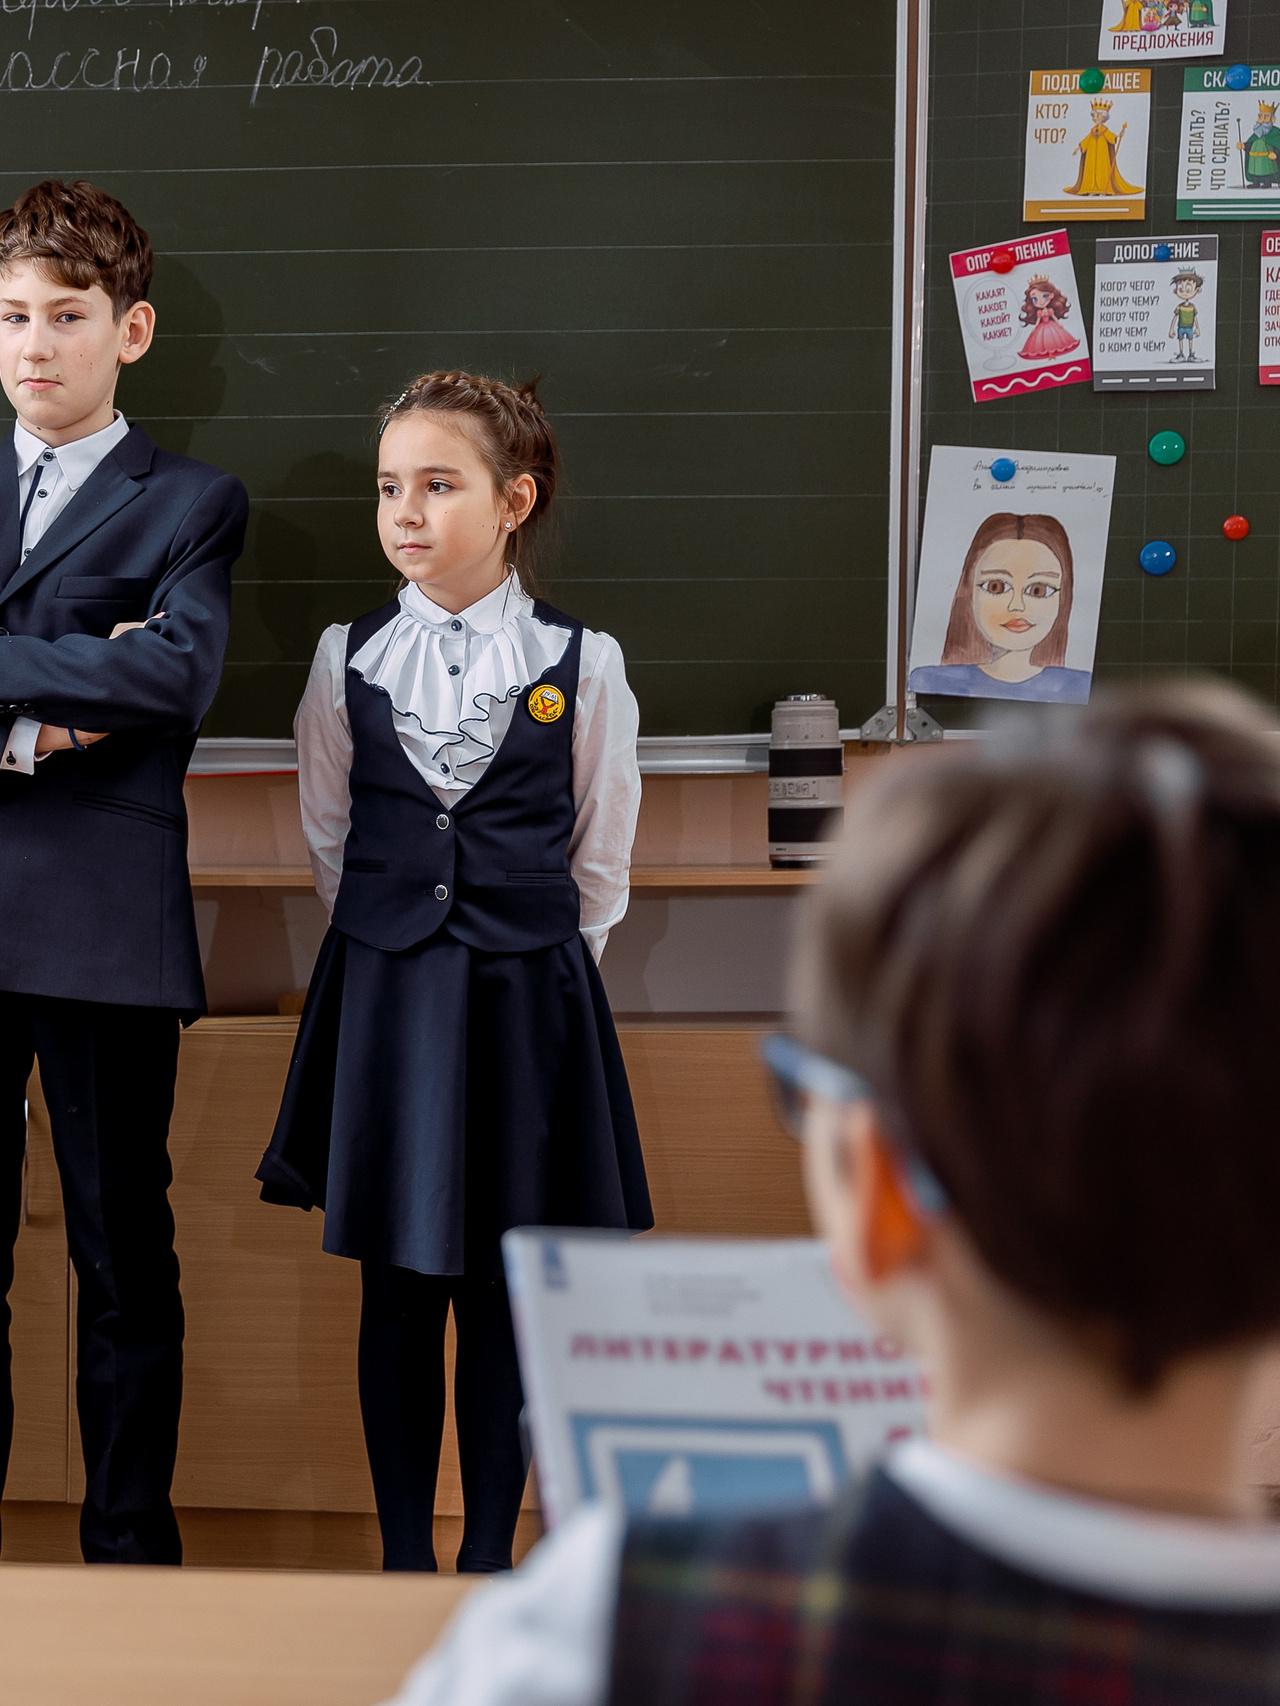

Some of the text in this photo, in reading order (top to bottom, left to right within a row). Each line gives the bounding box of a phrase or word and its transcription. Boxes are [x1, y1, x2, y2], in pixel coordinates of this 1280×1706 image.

[1112, 30, 1215, 52] ПРЕДЛОЖЕНИЯ
[1041, 71, 1141, 93] ПОДЛАЩЕЕ
[1035, 103, 1069, 119] КТО?
[1034, 127, 1067, 144] ЧТО?
[1186, 109, 1206, 191] ЧТО ДЕЛАТЬ?
[1210, 101, 1231, 191] ЧТО СДЕЛАТЬ?
[965, 238, 1056, 273] ОПРЛЕНИЕ
[1113, 242, 1200, 263] ДОПОЛЕНИЕ
[1100, 280, 1155, 291] КОГО? ЧЕГО?
[975, 287, 1006, 301] КАКАЯ?
[1100, 295, 1160, 307] КОМУ? ЧЕМУ?
[978, 300, 1008, 315] КАКОЕ?
[980, 312, 1011, 328] КАКОЙ?
[1100, 311, 1150, 322] КОГО? ЧТО?
[982, 326, 1012, 341] КАКИЕ?
[1099, 326, 1148, 337] КЕМ? ЧЕМ?
[1099, 339, 1166, 352] О КОМ? О ЧЁМ?
